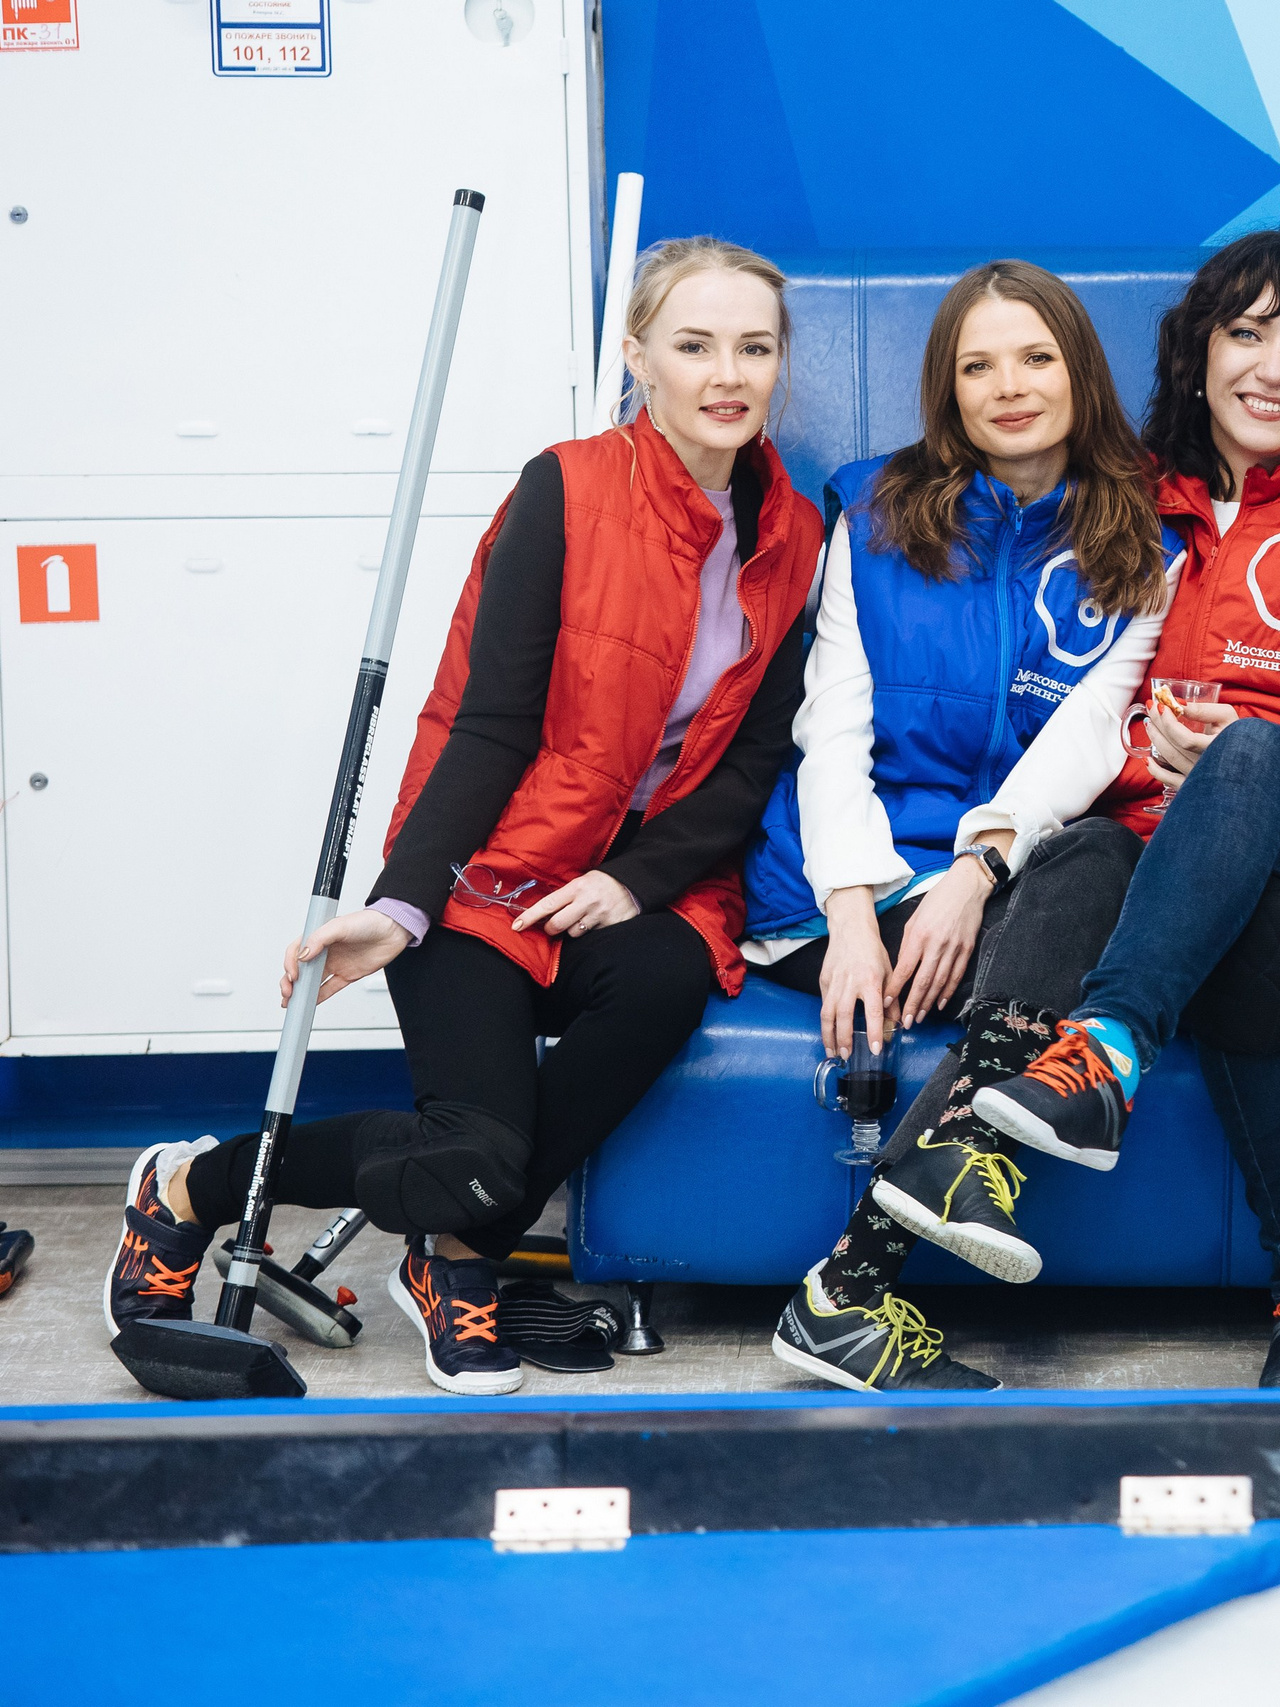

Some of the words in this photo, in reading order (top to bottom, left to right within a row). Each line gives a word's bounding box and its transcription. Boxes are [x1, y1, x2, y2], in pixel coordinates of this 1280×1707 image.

[234, 32, 273, 40] ПОЖАРЕ
[275, 32, 317, 41] ЗВОНИТЬ
[232, 45, 271, 64] 101,
[279, 46, 311, 62] 112
[357, 704, 380, 784] FIBREGLASS
[351, 784, 364, 817] FLAT
[343, 816, 357, 861] SHAFT
[243, 1131, 274, 1222] olsoncurling.com
[468, 1178, 494, 1207] TORRES
